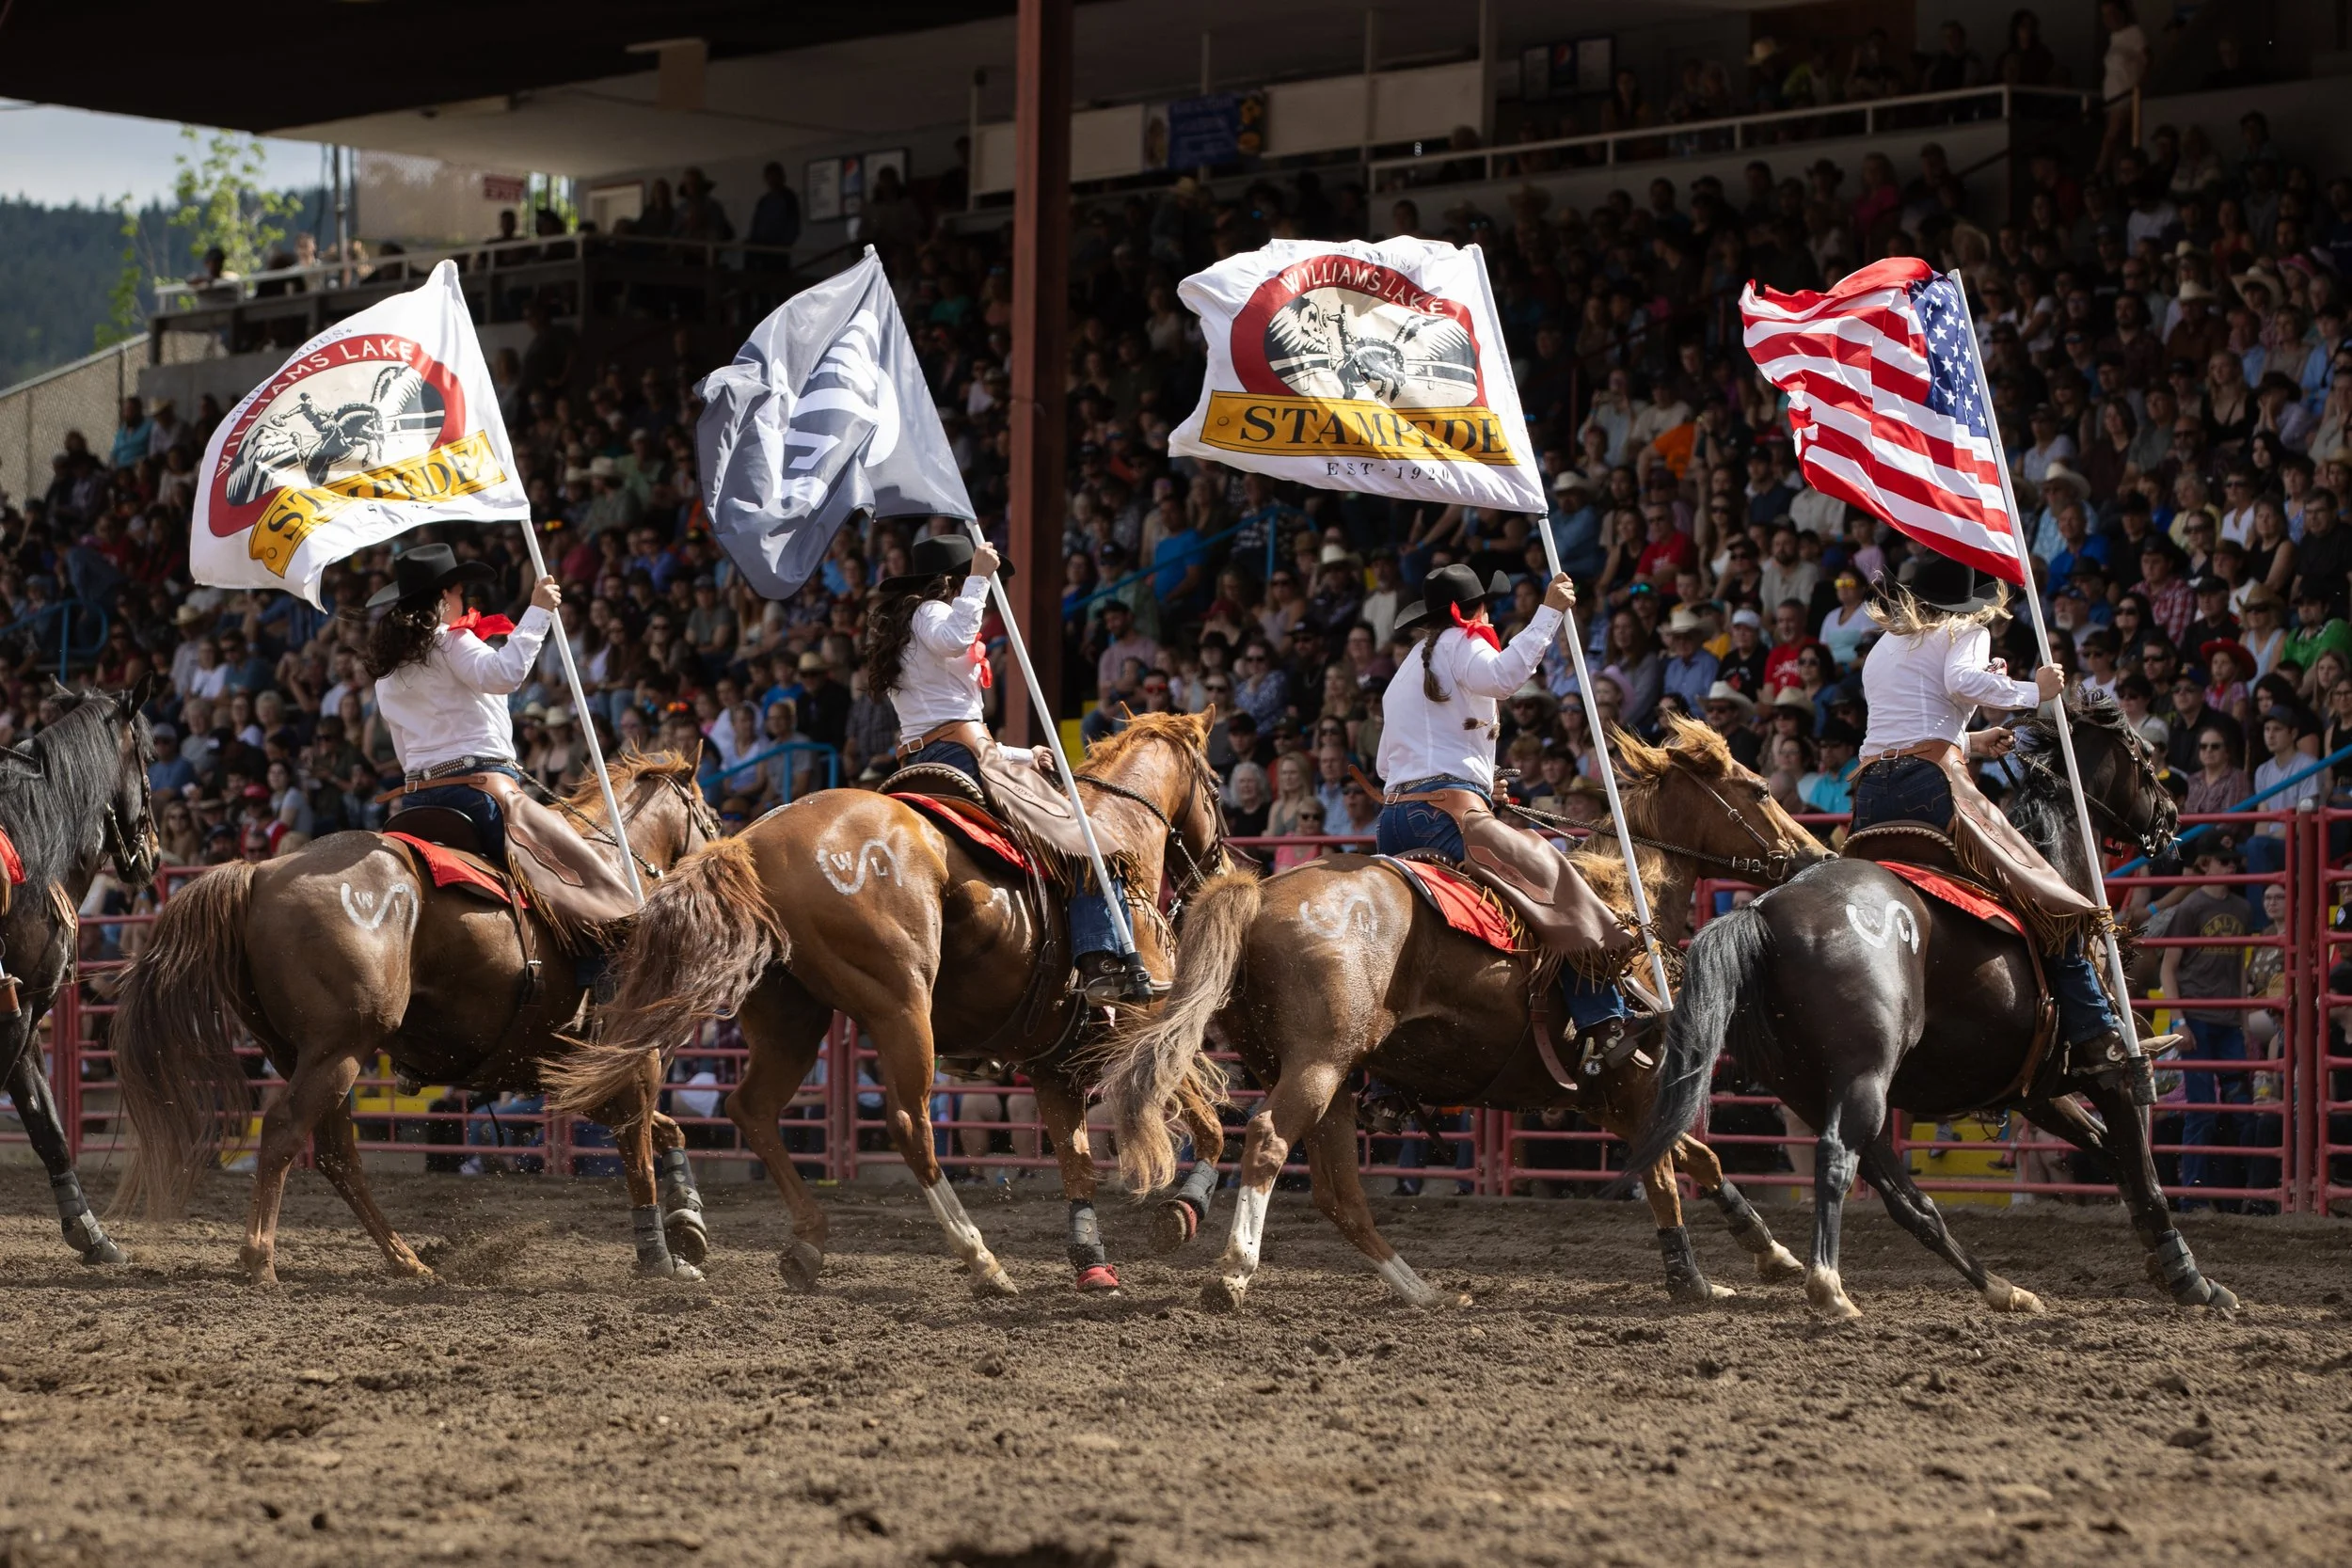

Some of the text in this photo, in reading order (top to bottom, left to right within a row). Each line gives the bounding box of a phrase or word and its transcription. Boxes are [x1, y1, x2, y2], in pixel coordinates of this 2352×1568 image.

[1279, 262, 1447, 315] WILLIAMS LAKE
[215, 339, 414, 478] WILLIAMS LAKE
[1240, 404, 1508, 453] STAMPEDE
[267, 449, 481, 542] STPEDE
[1327, 462, 1450, 482] EST 1920
